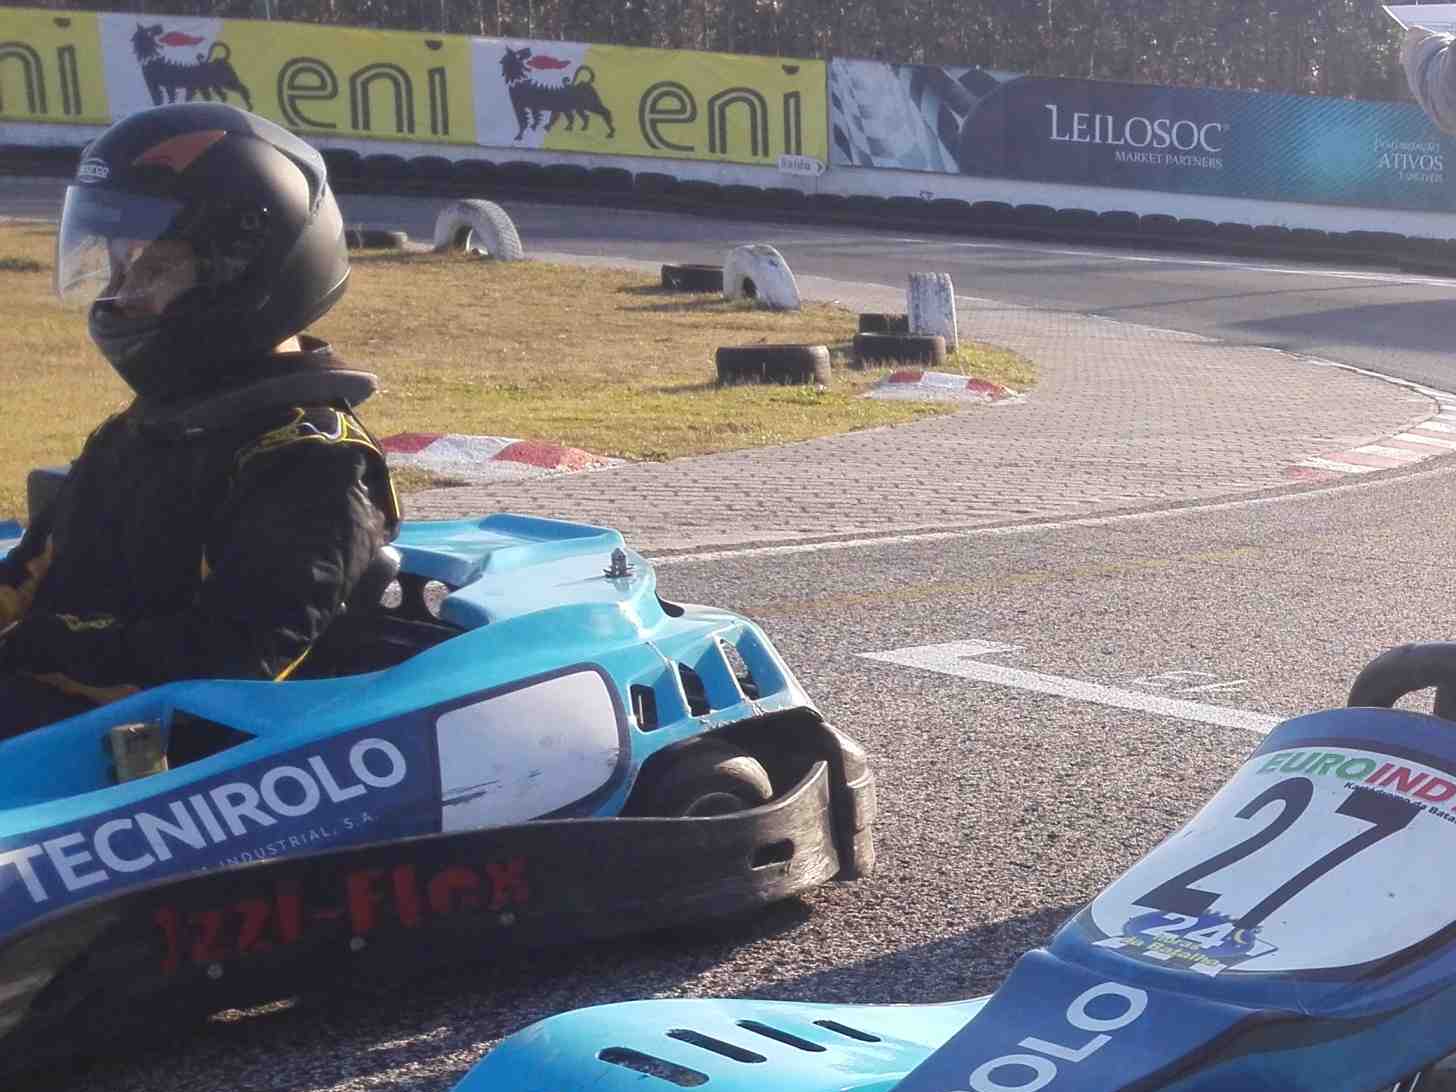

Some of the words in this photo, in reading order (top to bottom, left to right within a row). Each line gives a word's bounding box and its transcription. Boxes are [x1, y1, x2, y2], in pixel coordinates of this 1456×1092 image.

[277, 39, 449, 135] eni
[639, 64, 801, 157] eni
[1045, 104, 1223, 152] LEILOSOC
[1115, 151, 1164, 165] MARKET
[1166, 154, 1224, 169] PARTNERS
[1378, 152, 1444, 171] ATIVOS
[0, 738, 407, 904] TECNIROLO
[1131, 777, 1420, 931] 27
[1140, 912, 1236, 950] 24
